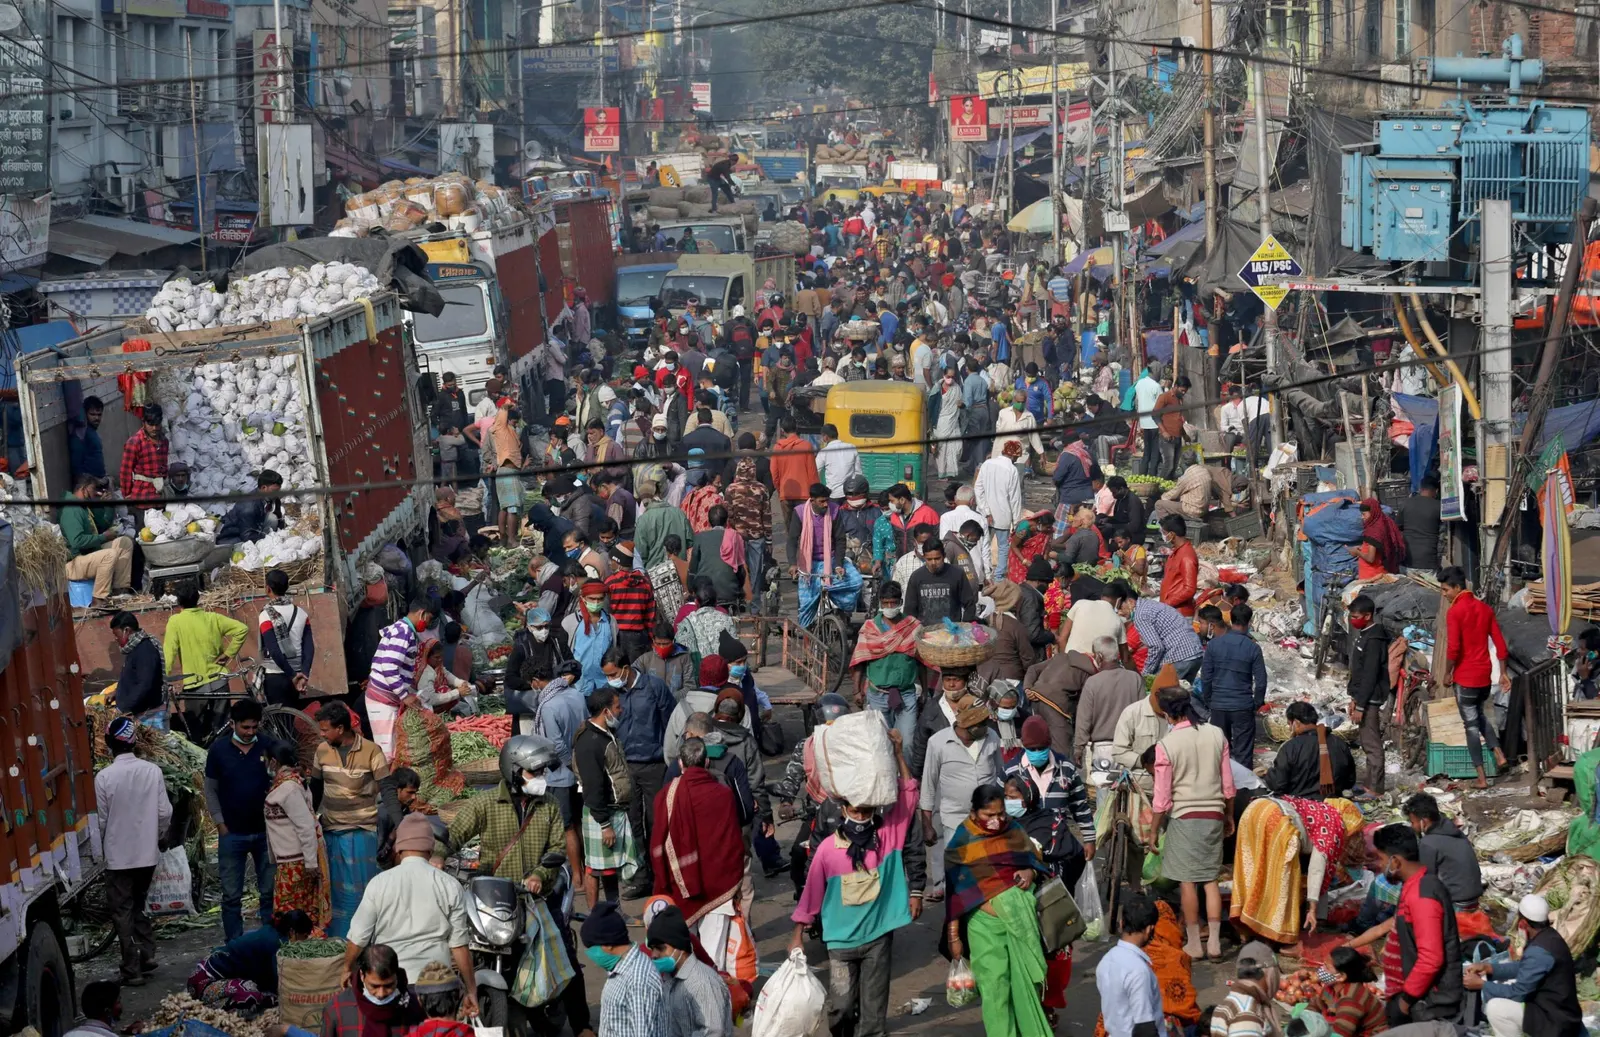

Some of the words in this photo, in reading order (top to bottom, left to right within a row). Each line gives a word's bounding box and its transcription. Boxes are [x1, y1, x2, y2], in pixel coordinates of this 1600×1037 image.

[551, 47, 590, 58] ORIENTAL
[1251, 260, 1292, 273] IAS/PSC
[920, 587, 950, 597] RUSHOUT
